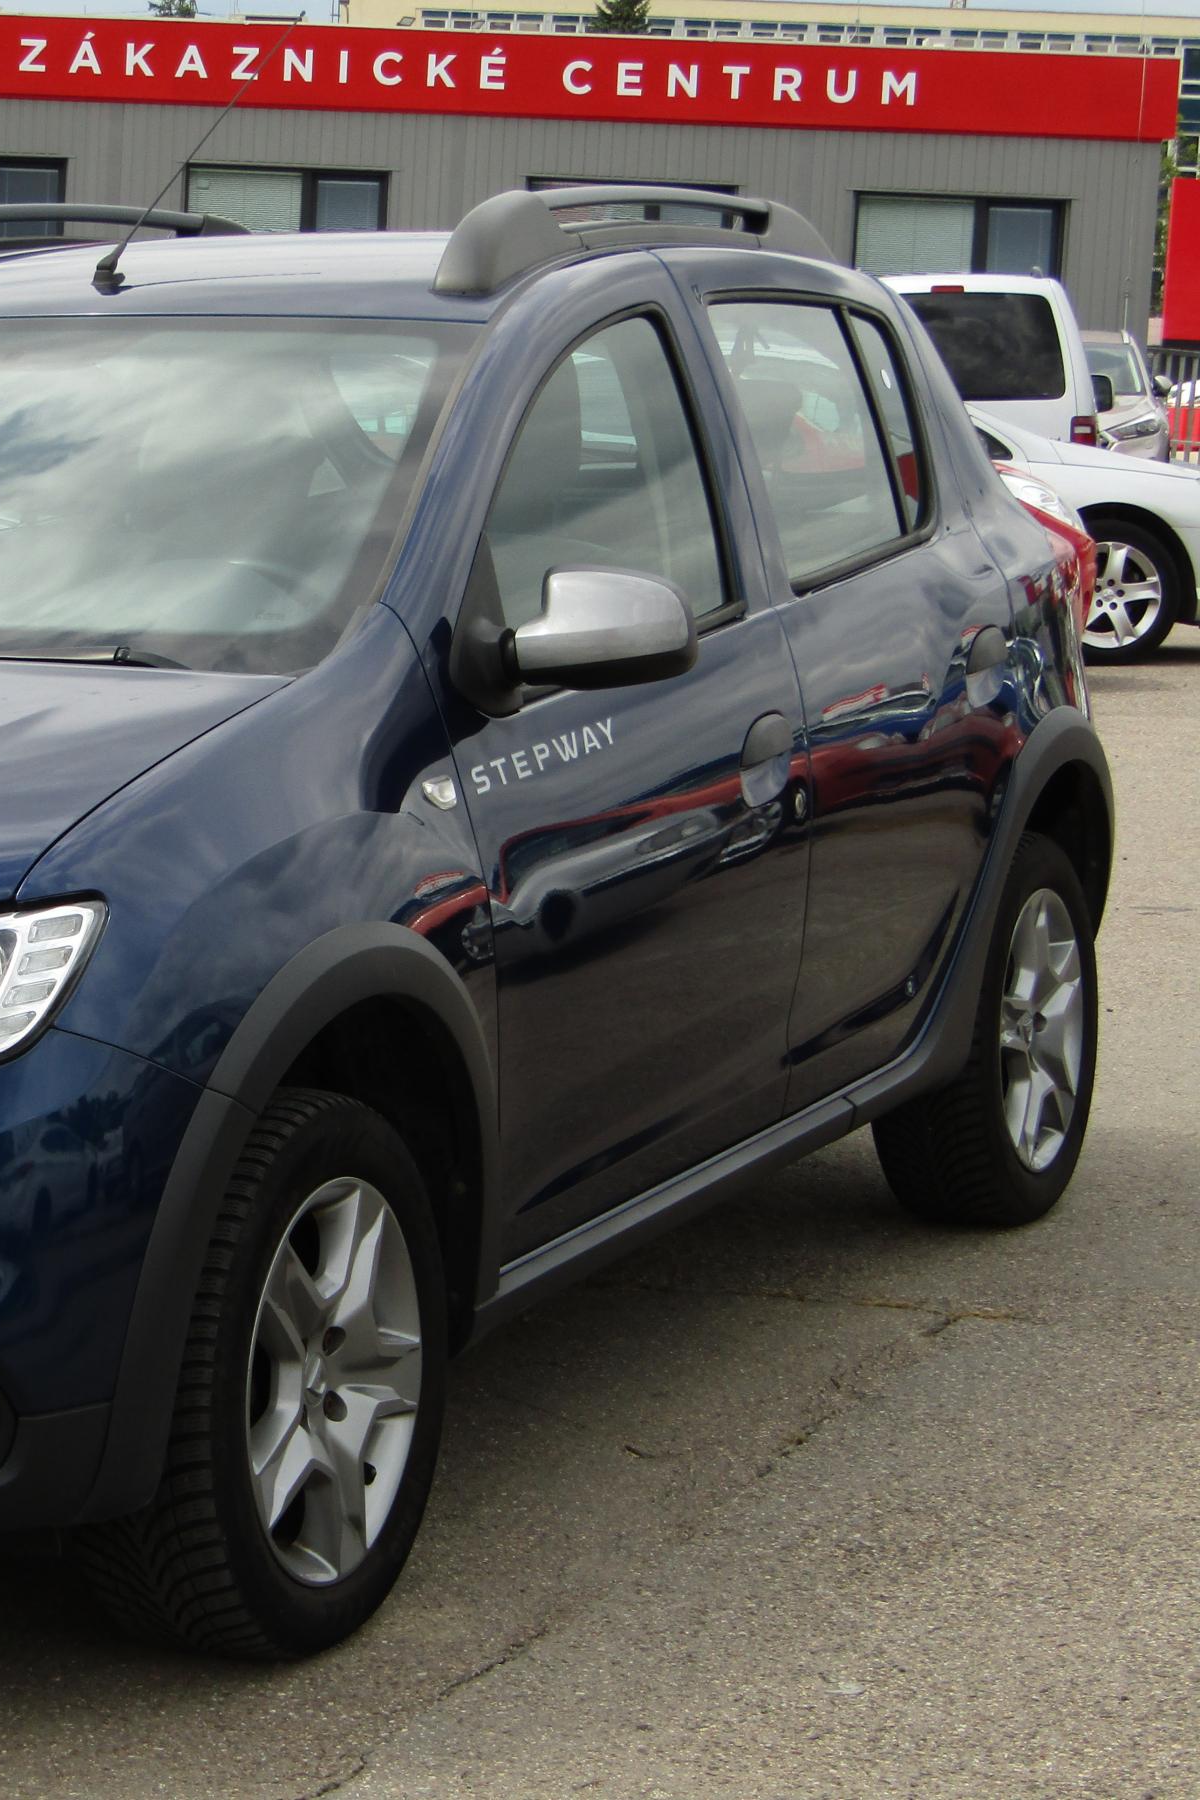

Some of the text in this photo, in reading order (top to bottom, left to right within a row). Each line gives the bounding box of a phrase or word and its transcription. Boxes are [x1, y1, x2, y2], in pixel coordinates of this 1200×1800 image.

[19, 33, 917, 106] ZÁKAZNICKÉ CENTRUM
[471, 717, 614, 795] STEPWAY
